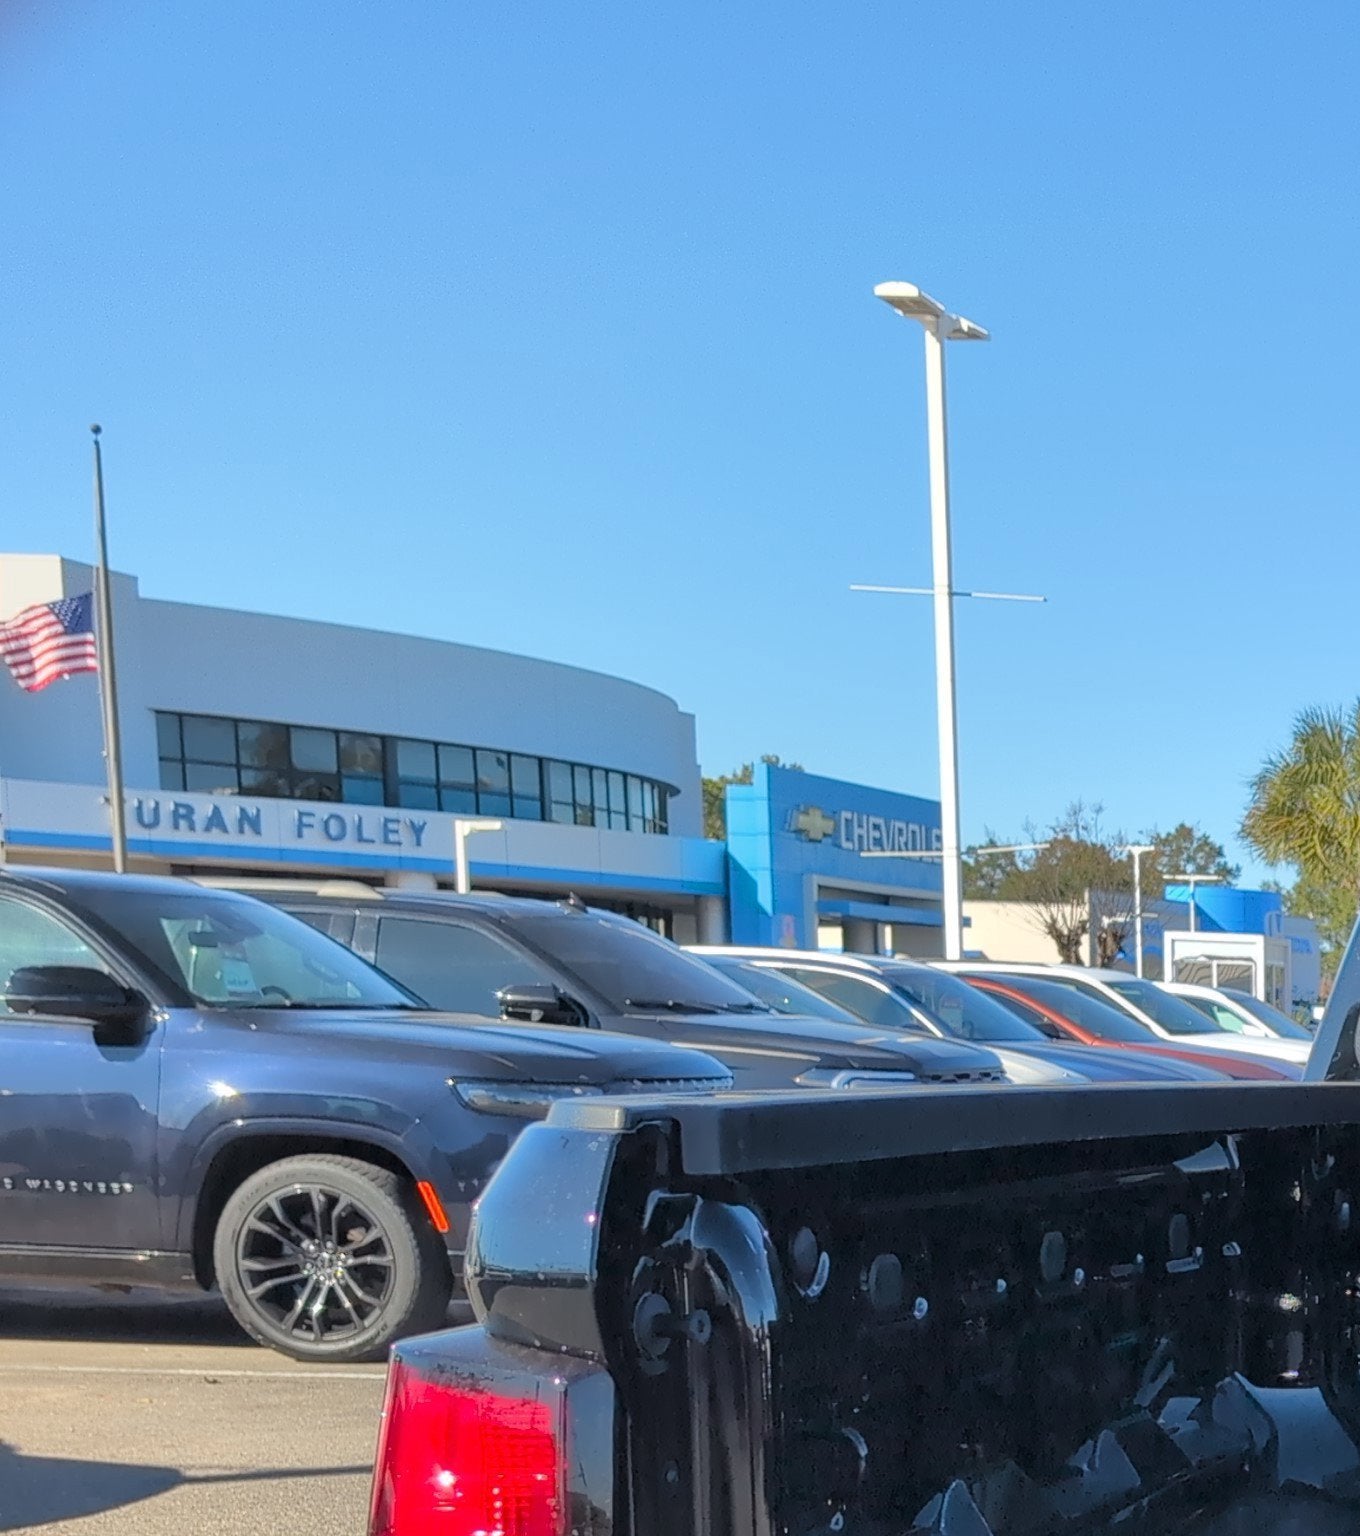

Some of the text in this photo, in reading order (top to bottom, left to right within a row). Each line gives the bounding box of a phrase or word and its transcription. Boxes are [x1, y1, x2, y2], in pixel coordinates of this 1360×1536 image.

[99, 797, 428, 848] URAN FOLEY
[840, 810, 943, 865] CHEVROLE
